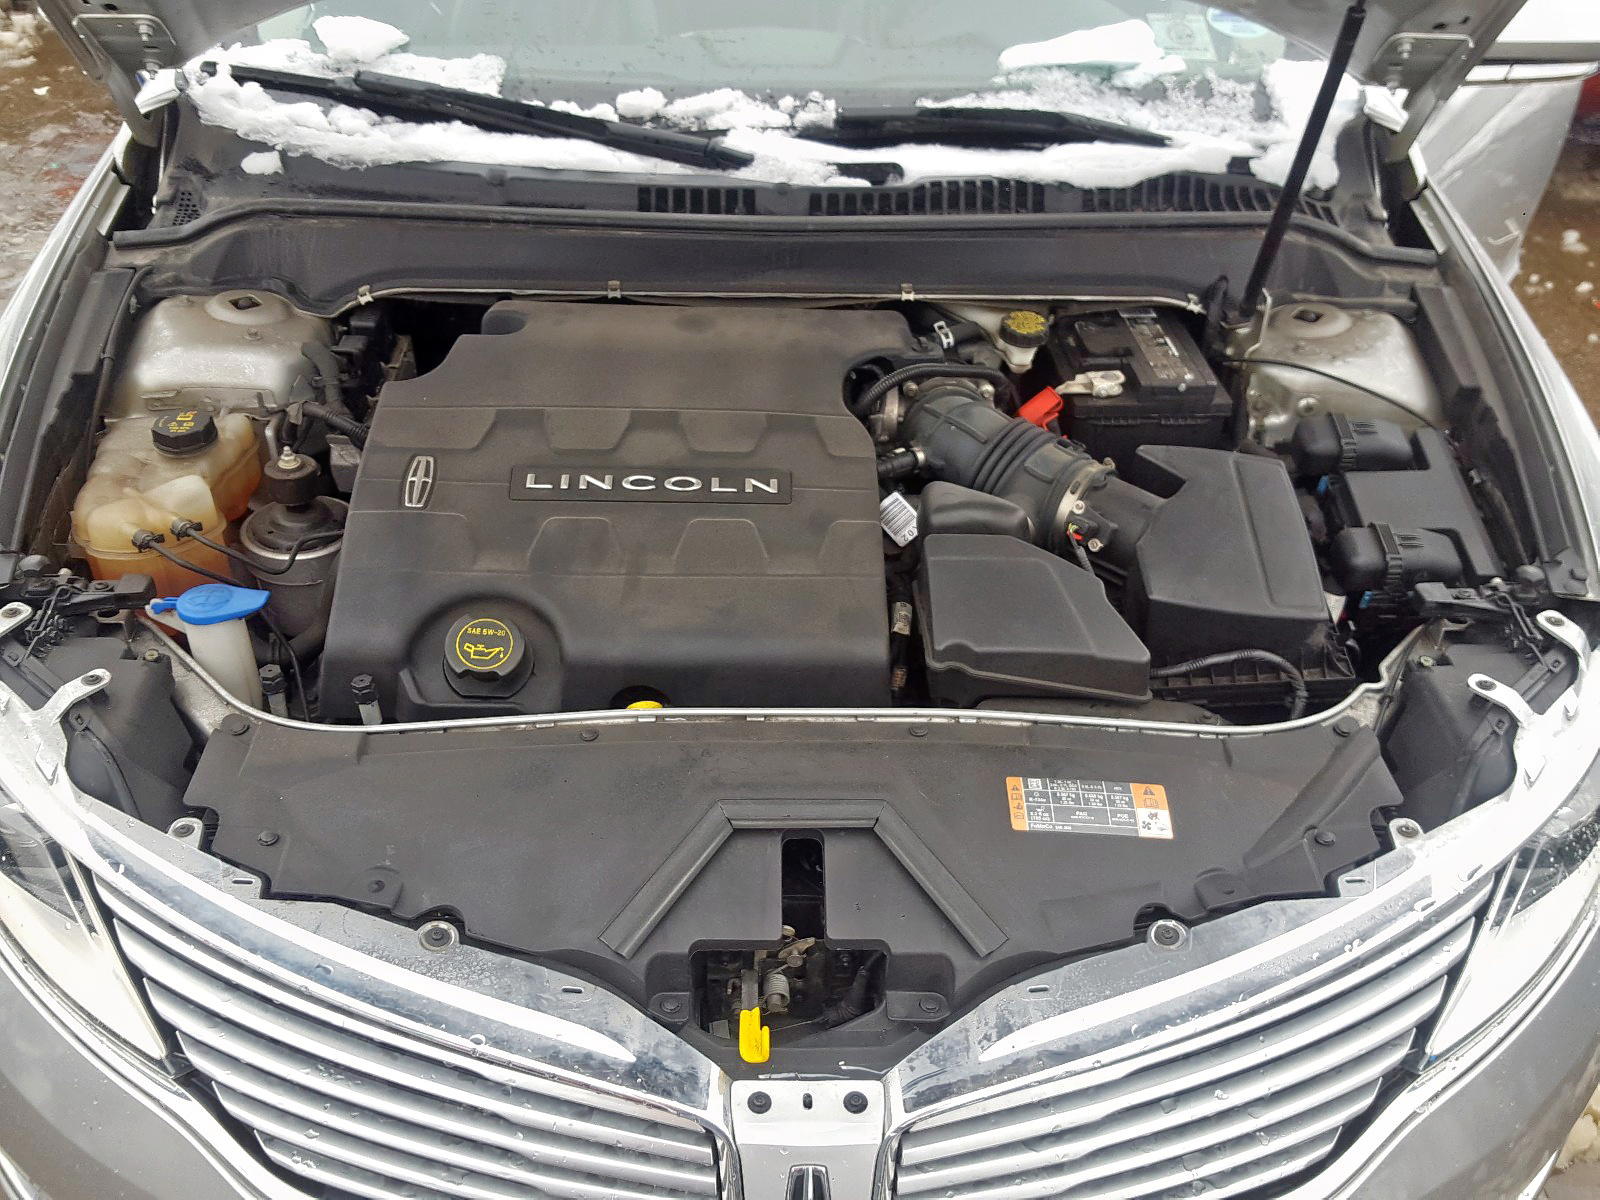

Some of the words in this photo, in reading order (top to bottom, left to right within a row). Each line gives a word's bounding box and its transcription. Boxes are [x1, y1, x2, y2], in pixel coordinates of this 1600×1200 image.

[525, 473, 778, 494] LINCOLN
[467, 627, 481, 635] SAE
[482, 628, 506, 637] 5W-20
